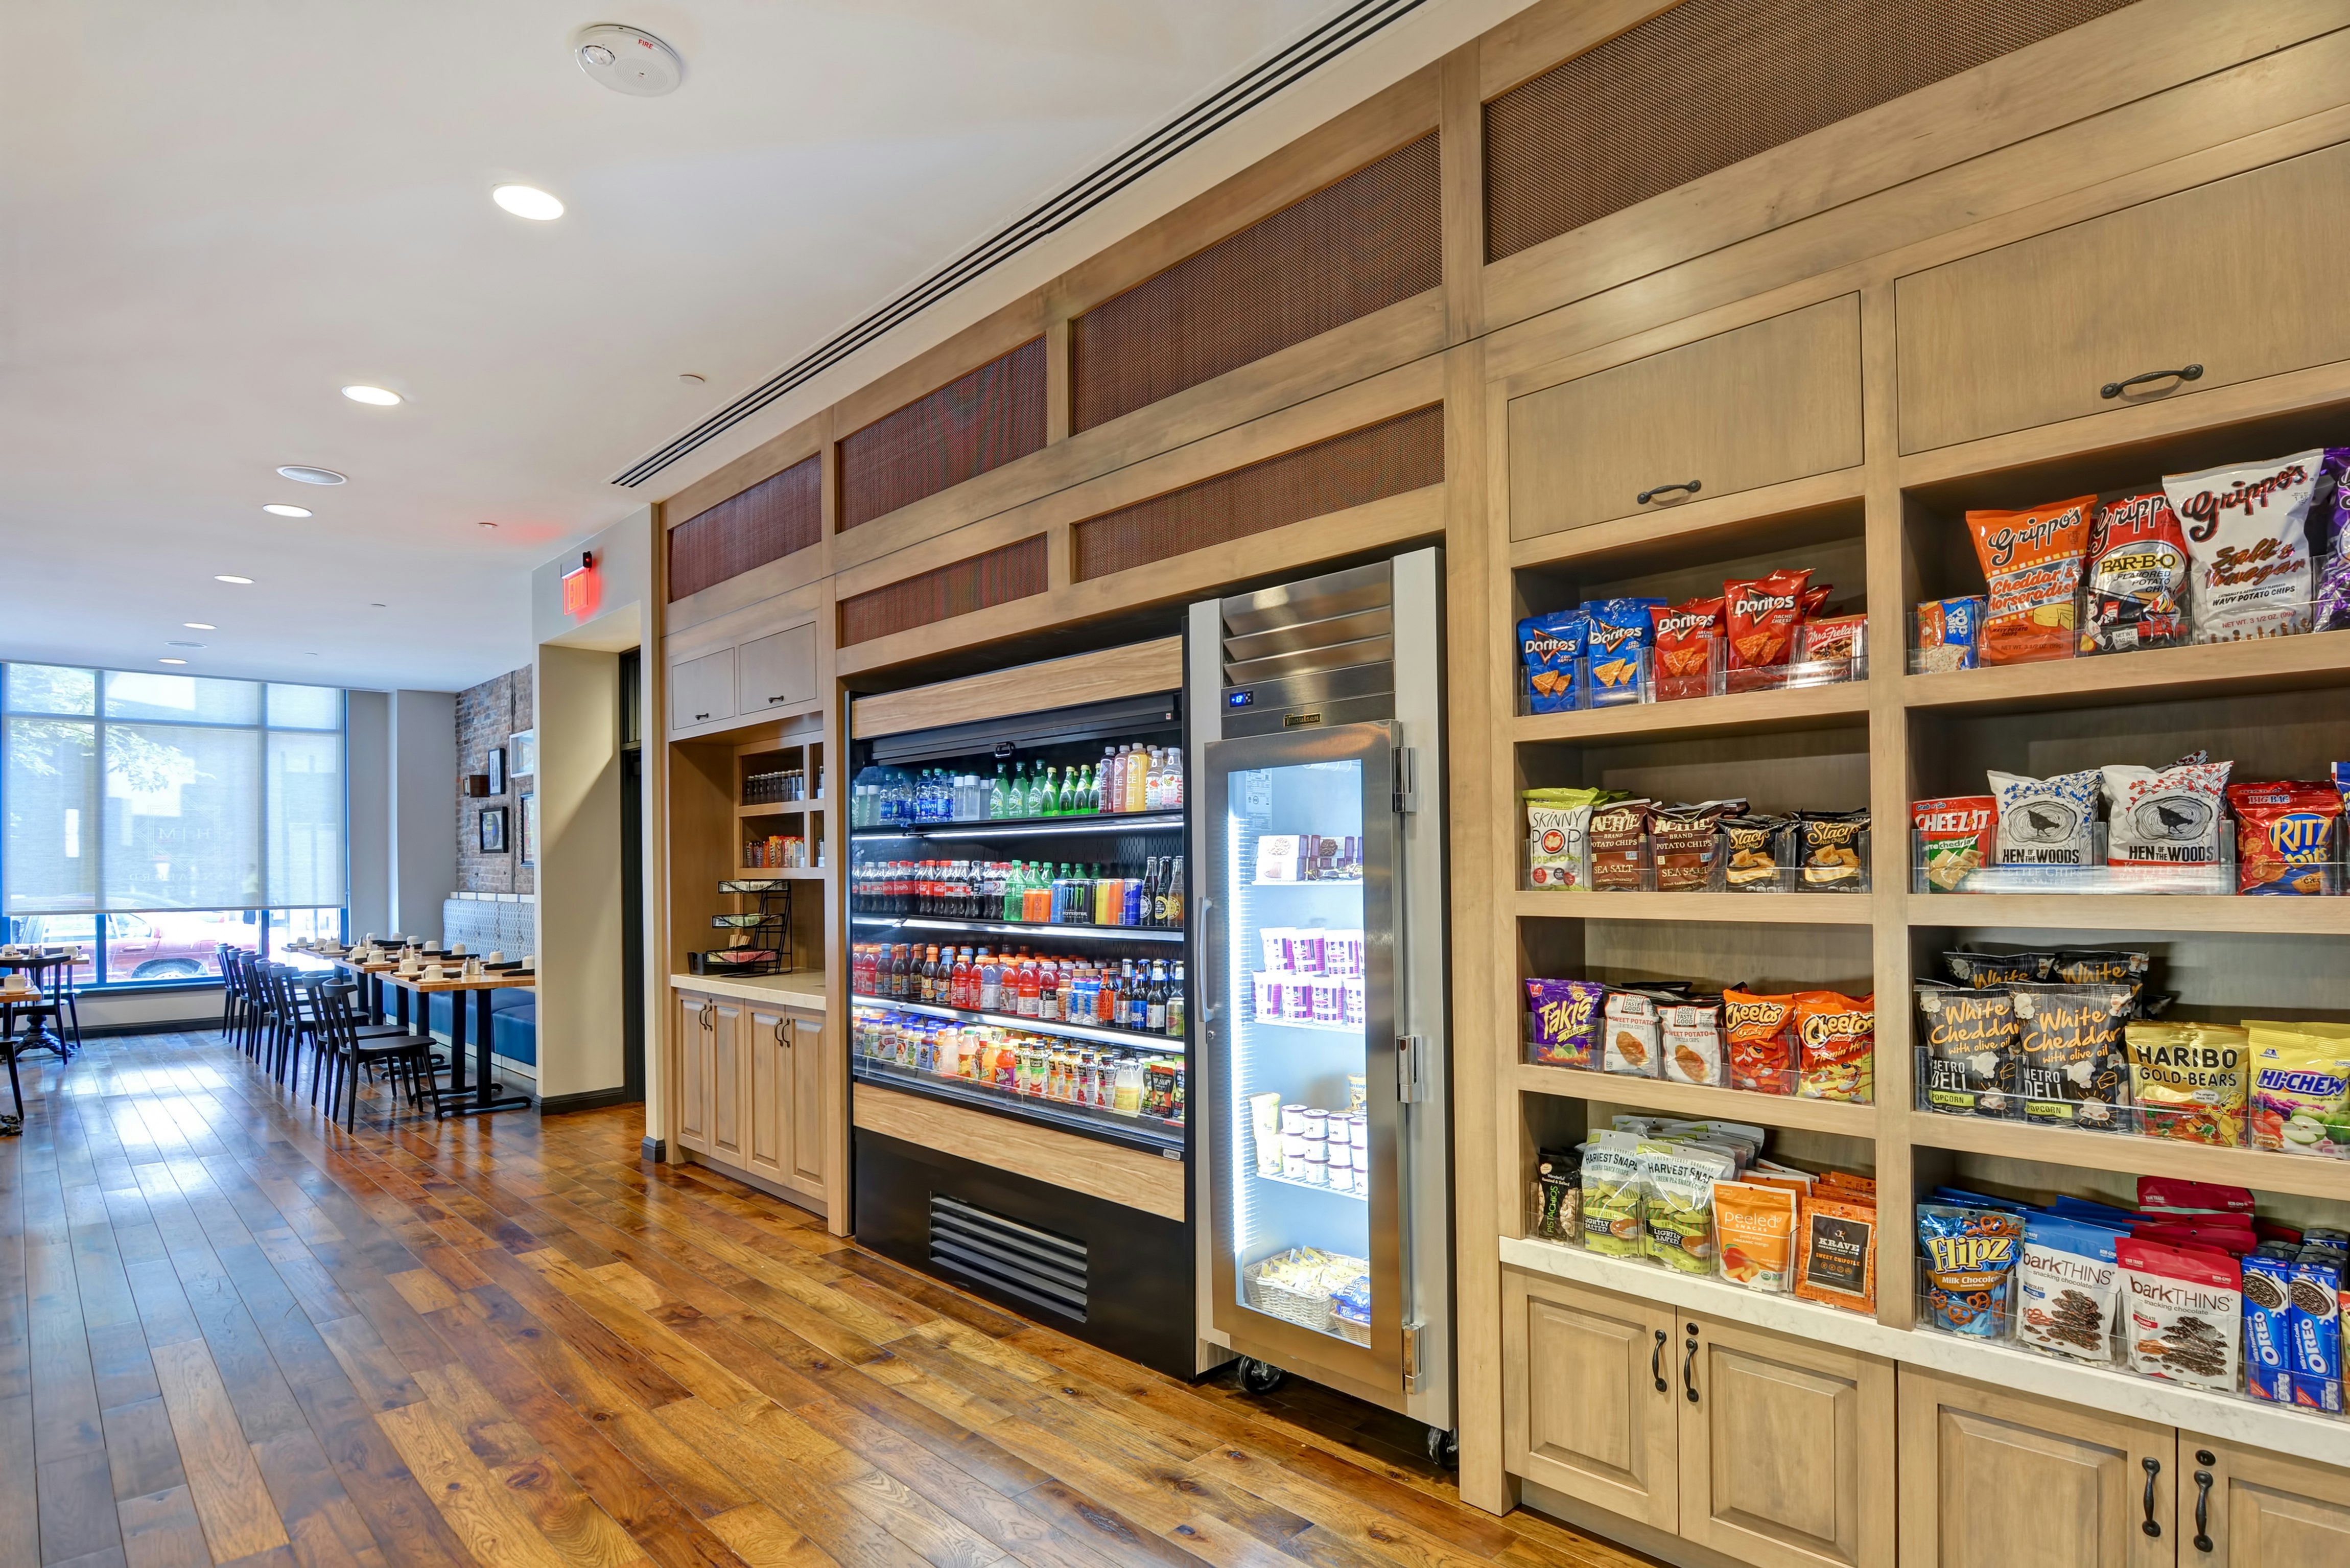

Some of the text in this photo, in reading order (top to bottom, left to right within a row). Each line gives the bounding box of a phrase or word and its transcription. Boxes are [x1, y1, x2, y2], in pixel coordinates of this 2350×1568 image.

[639, 39, 653, 50] FIRE
[2181, 465, 2308, 543] Grippo's
[1988, 506, 2082, 567] Grippo's
[2101, 554, 2176, 573] BAR-B-Q
[2212, 539, 2281, 569] Salt
[1992, 568, 2074, 596] Cheddar &
[2115, 571, 2171, 581] FLAVORED
[2205, 558, 2306, 589] Vinegar
[1989, 582, 2078, 611] Horseradish
[2238, 591, 2269, 602] POTATO
[2271, 586, 2295, 595] CHIPS
[1735, 595, 1794, 616] Doritos
[1658, 615, 1716, 631] Doritos
[1589, 627, 1643, 645] Doritos
[1525, 639, 1576, 653] Doritos
[1533, 829, 1582, 854] POP
[1729, 828, 1770, 850] Stacy's
[1807, 822, 1861, 845] Stacy's
[2272, 818, 2332, 852] RITZ
[1656, 842, 1685, 850] POTATO
[2129, 846, 2154, 860] HEN
[2167, 846, 2214, 862] WOODS
[1533, 855, 1582, 864] POPCORN
[2003, 850, 2025, 863] HEN
[2036, 849, 2079, 863] WOODS
[2285, 847, 2328, 869] bits
[1594, 864, 1633, 874] SEA SALT
[1662, 866, 1708, 877] SEA SALT
[2000, 866, 2082, 878] KETTLE CHIPS
[2032, 877, 2066, 885] SALTED
[1973, 970, 2032, 989] White
[2062, 963, 2127, 985] White
[1539, 997, 1593, 1040] Takis
[1726, 1004, 1783, 1030] Cheetos
[1945, 1001, 2010, 1025] White
[2039, 1008, 2107, 1032] White
[1736, 1026, 1766, 1037] Crunchy
[1804, 1014, 1874, 1047] Cheetos
[1830, 1035, 1856, 1043] Crunchy
[1931, 1018, 2019, 1044] Cheddar
[2023, 1026, 2123, 1052] Cheddar
[1948, 1037, 2011, 1055] with olive oil
[2042, 1046, 2108, 1064] with olive oil
[1932, 1059, 1965, 1073] METRO
[2136, 1044, 2238, 1069] HARIBO
[1931, 1072, 1966, 1091] DELI
[2024, 1068, 2060, 1082] METRO
[2140, 1067, 2237, 1087] GOLD-BEARS
[2257, 1069, 2347, 1095] HI-CHEW
[1932, 1094, 1964, 1104] POPCORN
[2024, 1081, 2061, 1100] DELI
[2027, 1104, 2061, 1114] POPCORN
[1585, 1153, 1638, 1171] HARVEST SNAPS
[1648, 1162, 1688, 1177] HARVEST
[1547, 1185, 1558, 1233] PISTACHIOS
[1725, 1211, 1777, 1228] peeled
[1735, 1224, 1768, 1232] SNACKS
[1654, 1228, 1681, 1241] LIGHTLY
[1818, 1237, 1860, 1252] KRAVE
[1816, 1252, 1861, 1267] SWEET CHIPOTLE
[1929, 1237, 2011, 1272] Flipz
[2024, 1253, 2112, 1285] barkTHINS
[2033, 1270, 2093, 1290] snacking chocolate
[2130, 1275, 2230, 1312] barkTHINS
[2144, 1299, 2208, 1316] snacking chocolate
[2254, 1311, 2280, 1366] OREO
[2301, 1319, 2328, 1374] OREO
